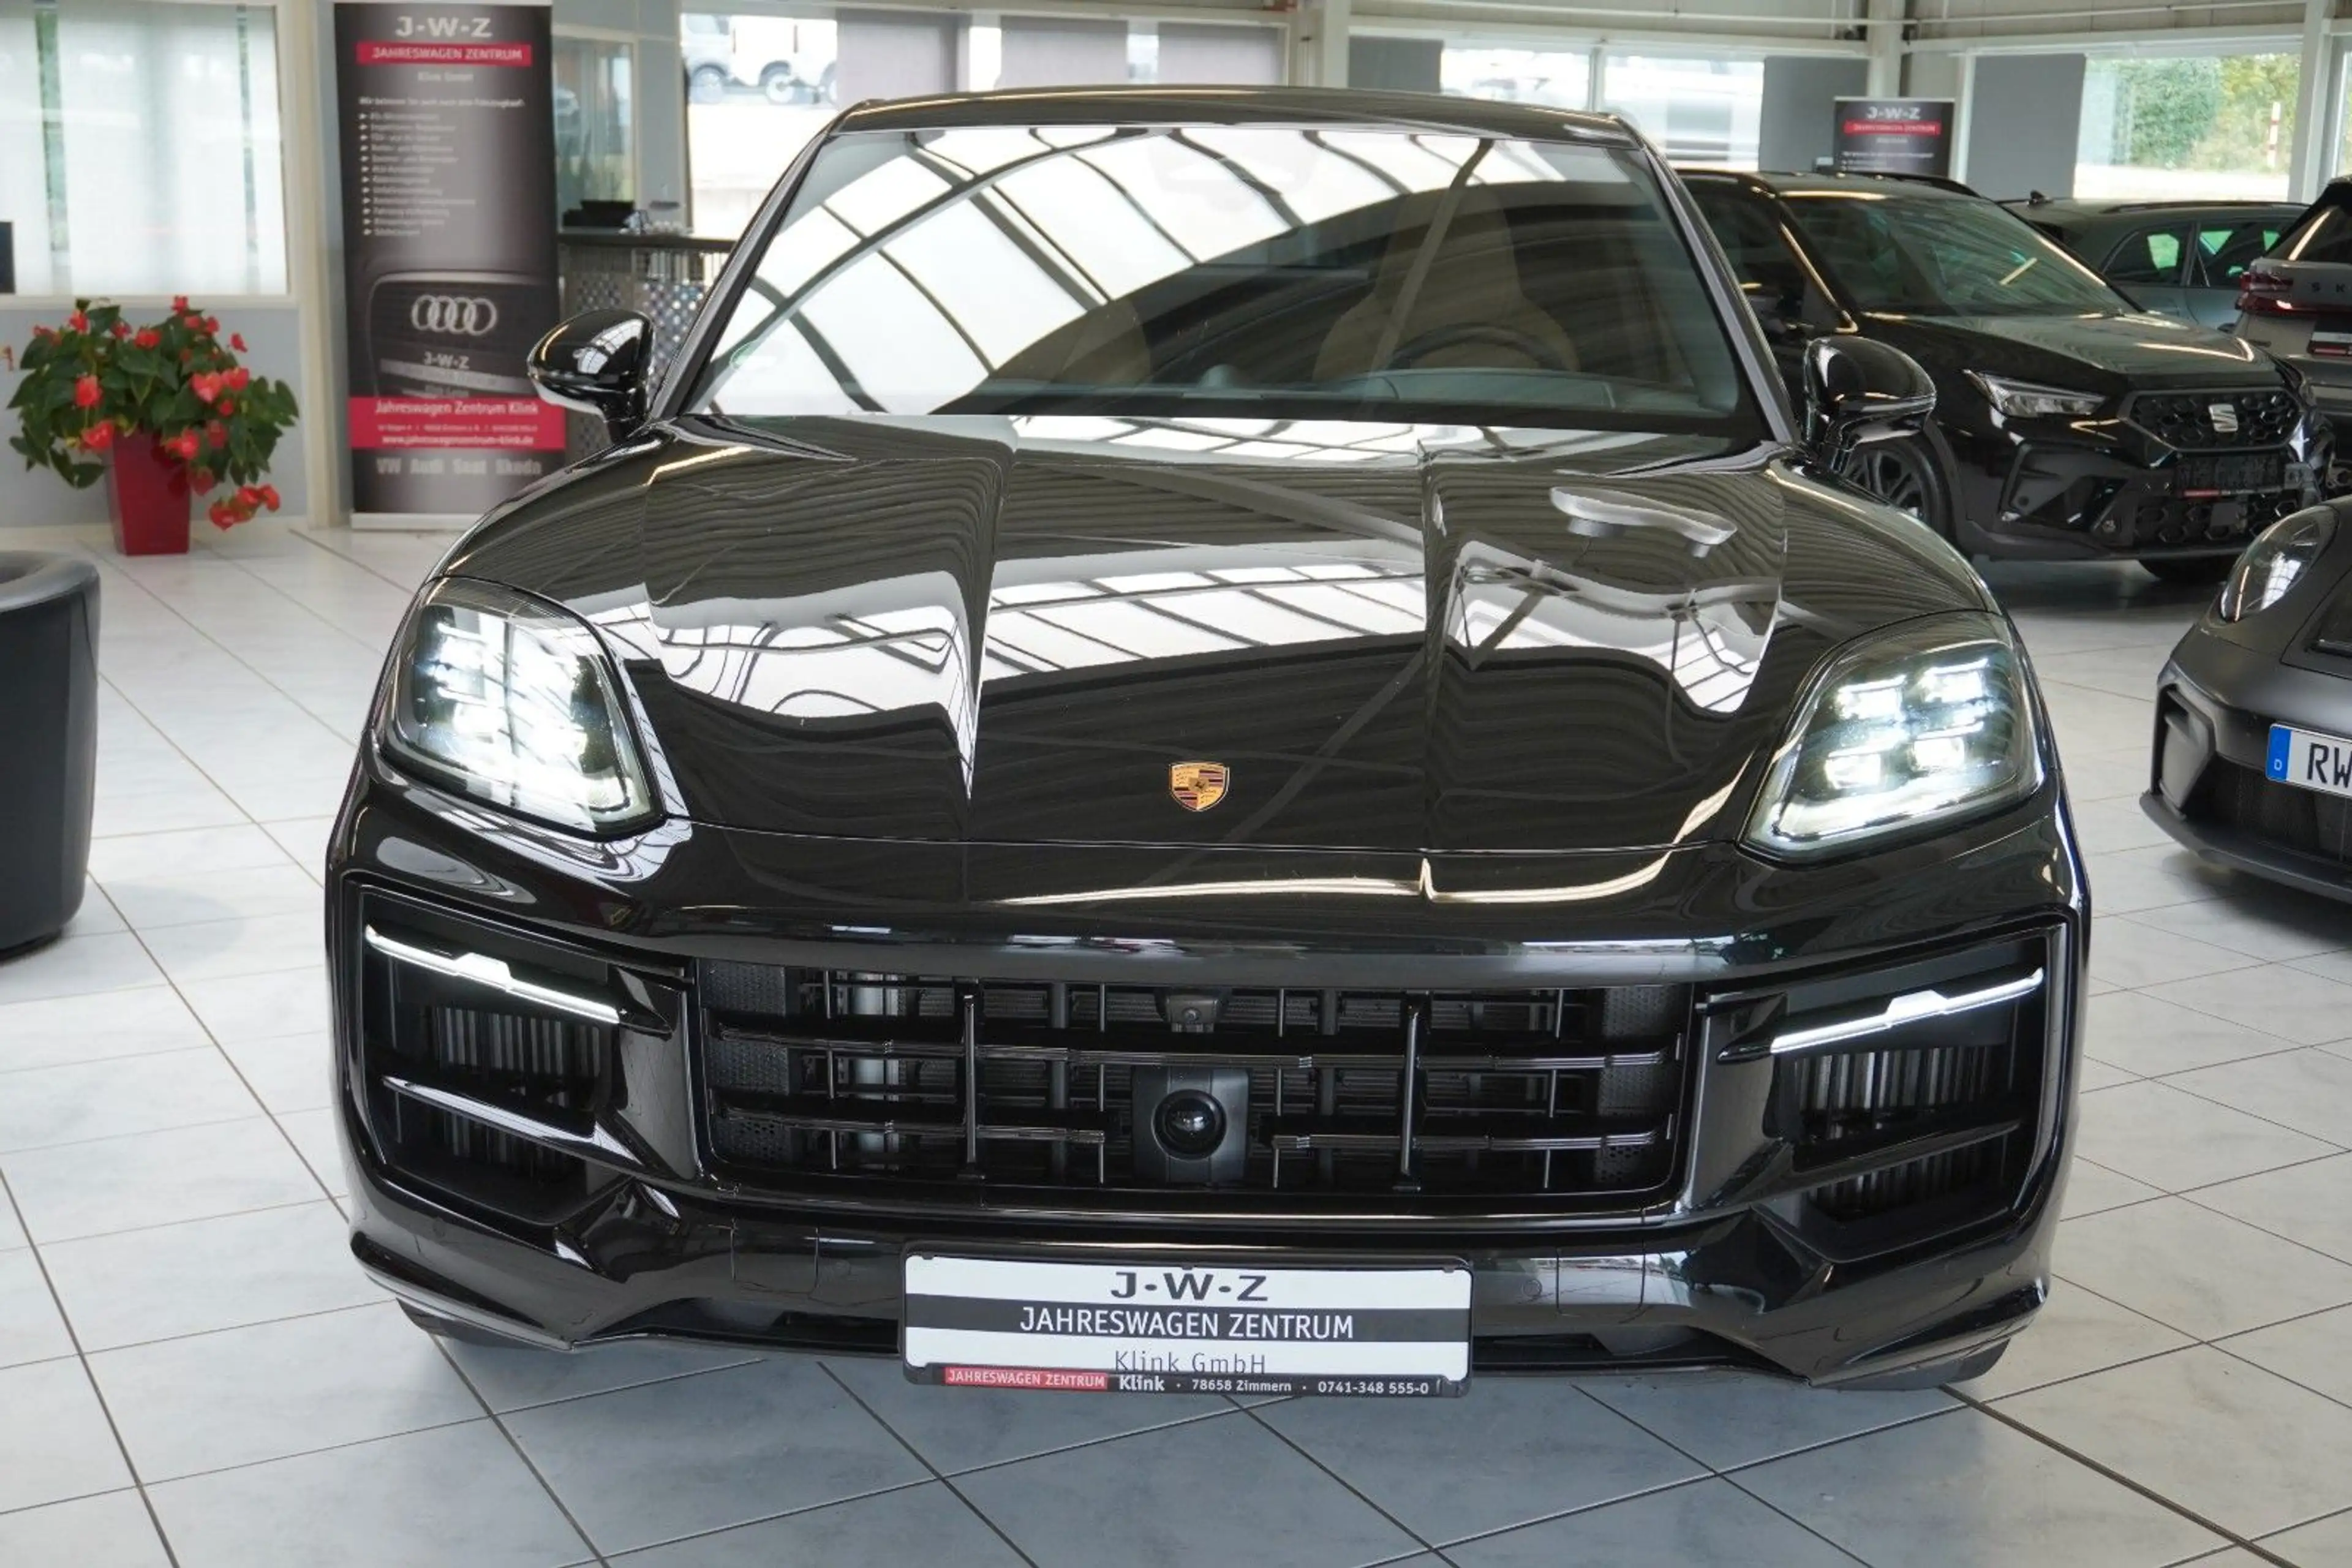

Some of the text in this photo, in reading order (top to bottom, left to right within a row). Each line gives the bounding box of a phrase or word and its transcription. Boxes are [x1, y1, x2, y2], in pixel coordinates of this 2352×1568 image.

[372, 47, 523, 61] JAHRESWAGEN ZENTRUM
[454, 401, 507, 415] Zentrum
[2274, 758, 2283, 771] D
[1020, 1306, 1354, 1339] JAHRESWAGEN ZENTRUM
[1115, 1350, 1266, 1374] Klink GmbH
[948, 1368, 1430, 1395] JAHRESWAGEN ZENTRUM Klink 78658 Zimmern 0741-348 555-0
